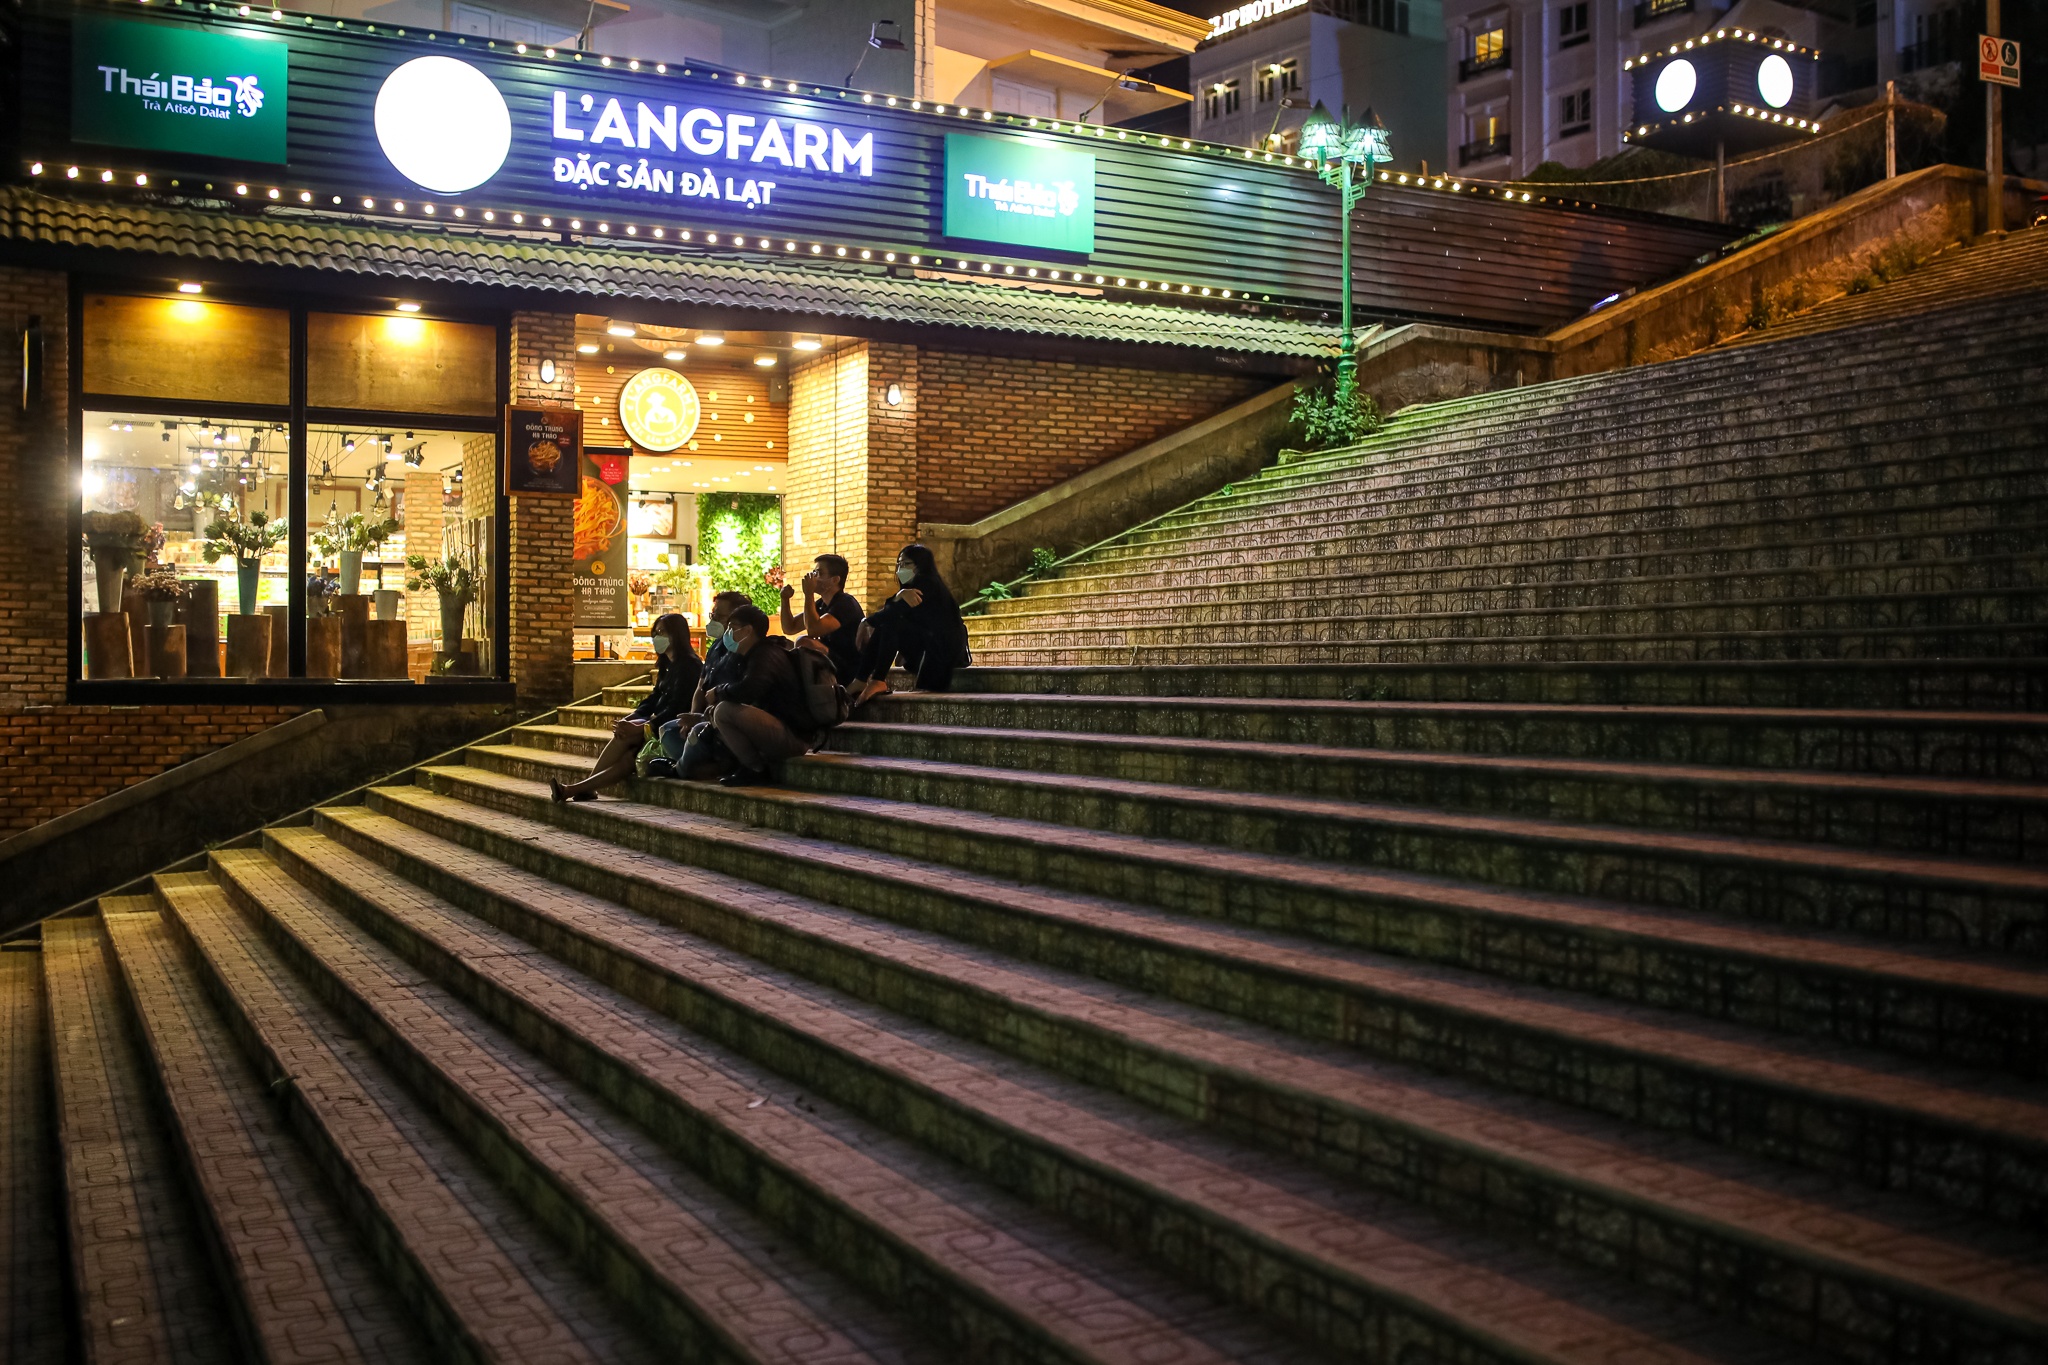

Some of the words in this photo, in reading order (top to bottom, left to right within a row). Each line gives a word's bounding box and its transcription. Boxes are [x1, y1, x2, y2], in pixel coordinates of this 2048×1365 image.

[98, 65, 168, 99] Thái
[171, 75, 232, 107] Bảo
[142, 99, 161, 111] Trà
[164, 102, 197, 116] Atisô
[199, 106, 231, 120] Dalat
[553, 90, 873, 177] L'ANGFARM
[553, 152, 611, 190] ĐẶC
[616, 158, 674, 194] SẢN
[679, 167, 720, 199] ĐÀ
[725, 177, 776, 210] LẠT
